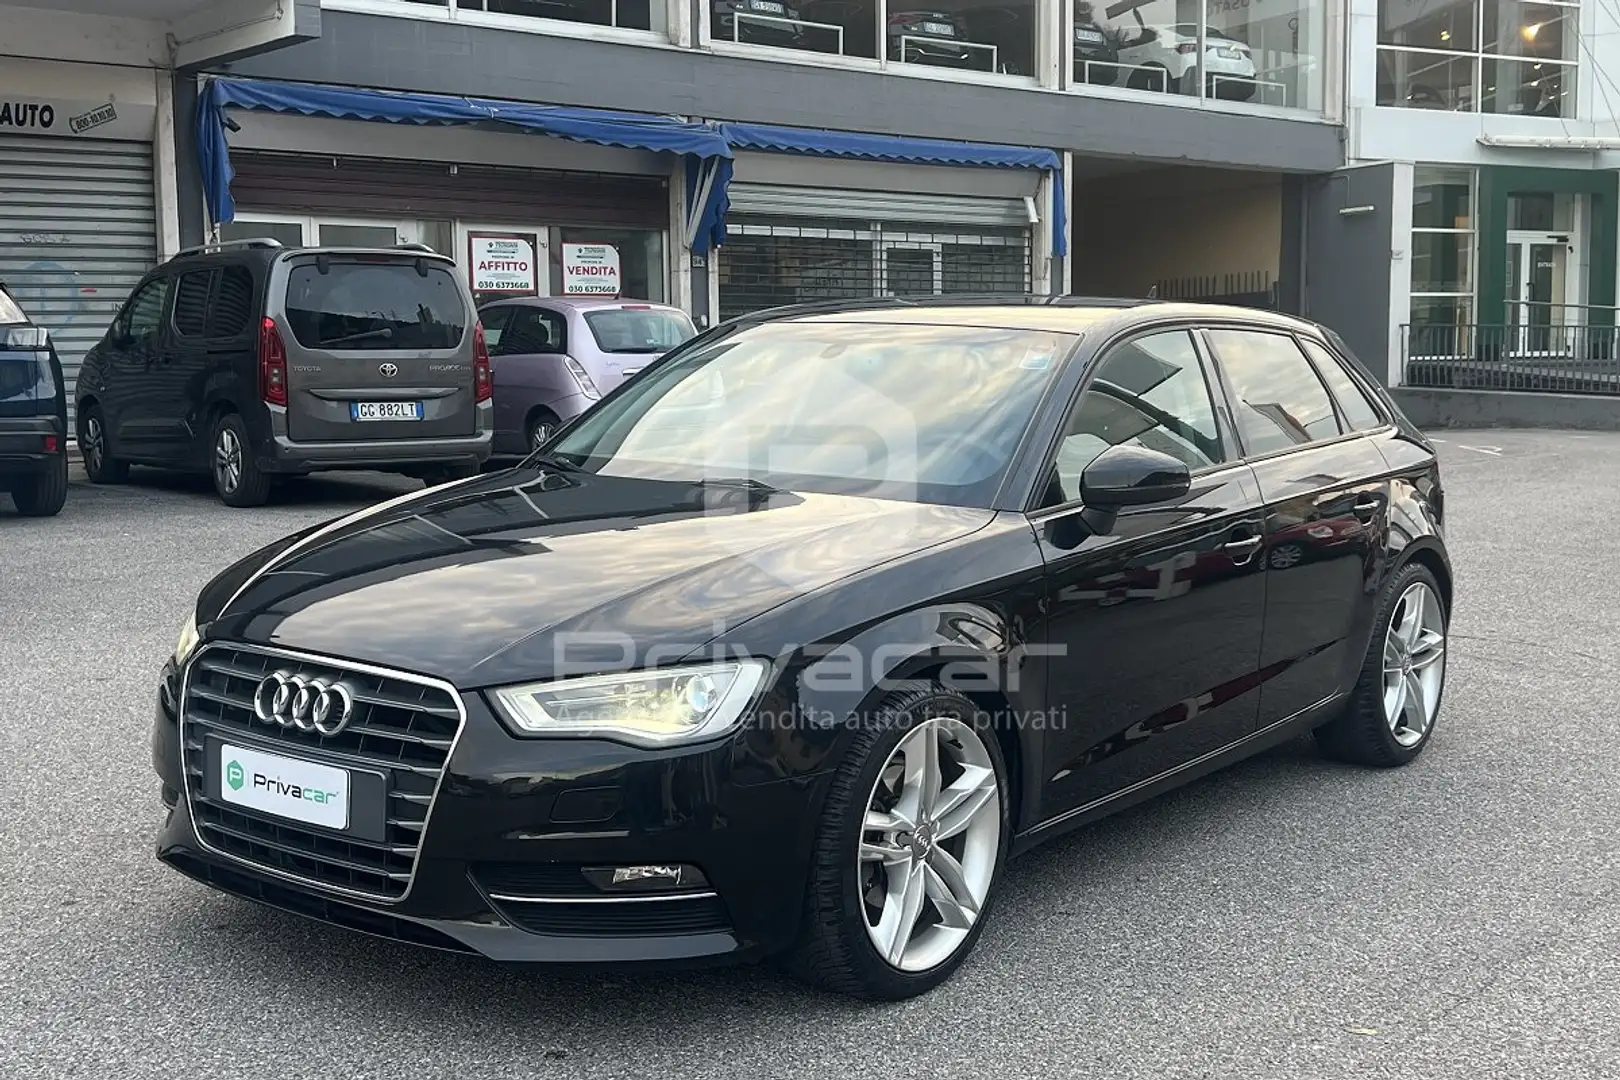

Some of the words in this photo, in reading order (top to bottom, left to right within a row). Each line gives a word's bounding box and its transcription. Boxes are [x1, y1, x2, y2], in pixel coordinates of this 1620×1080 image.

[0, 102, 54, 128] AUTO
[479, 260, 528, 271] AFFITTO
[567, 265, 616, 276] VENDITA
[478, 281, 494, 289] 030
[568, 285, 583, 293] 030
[360, 403, 375, 417] GG
[379, 403, 415, 417] 882LT
[253, 773, 338, 804] Privacar
